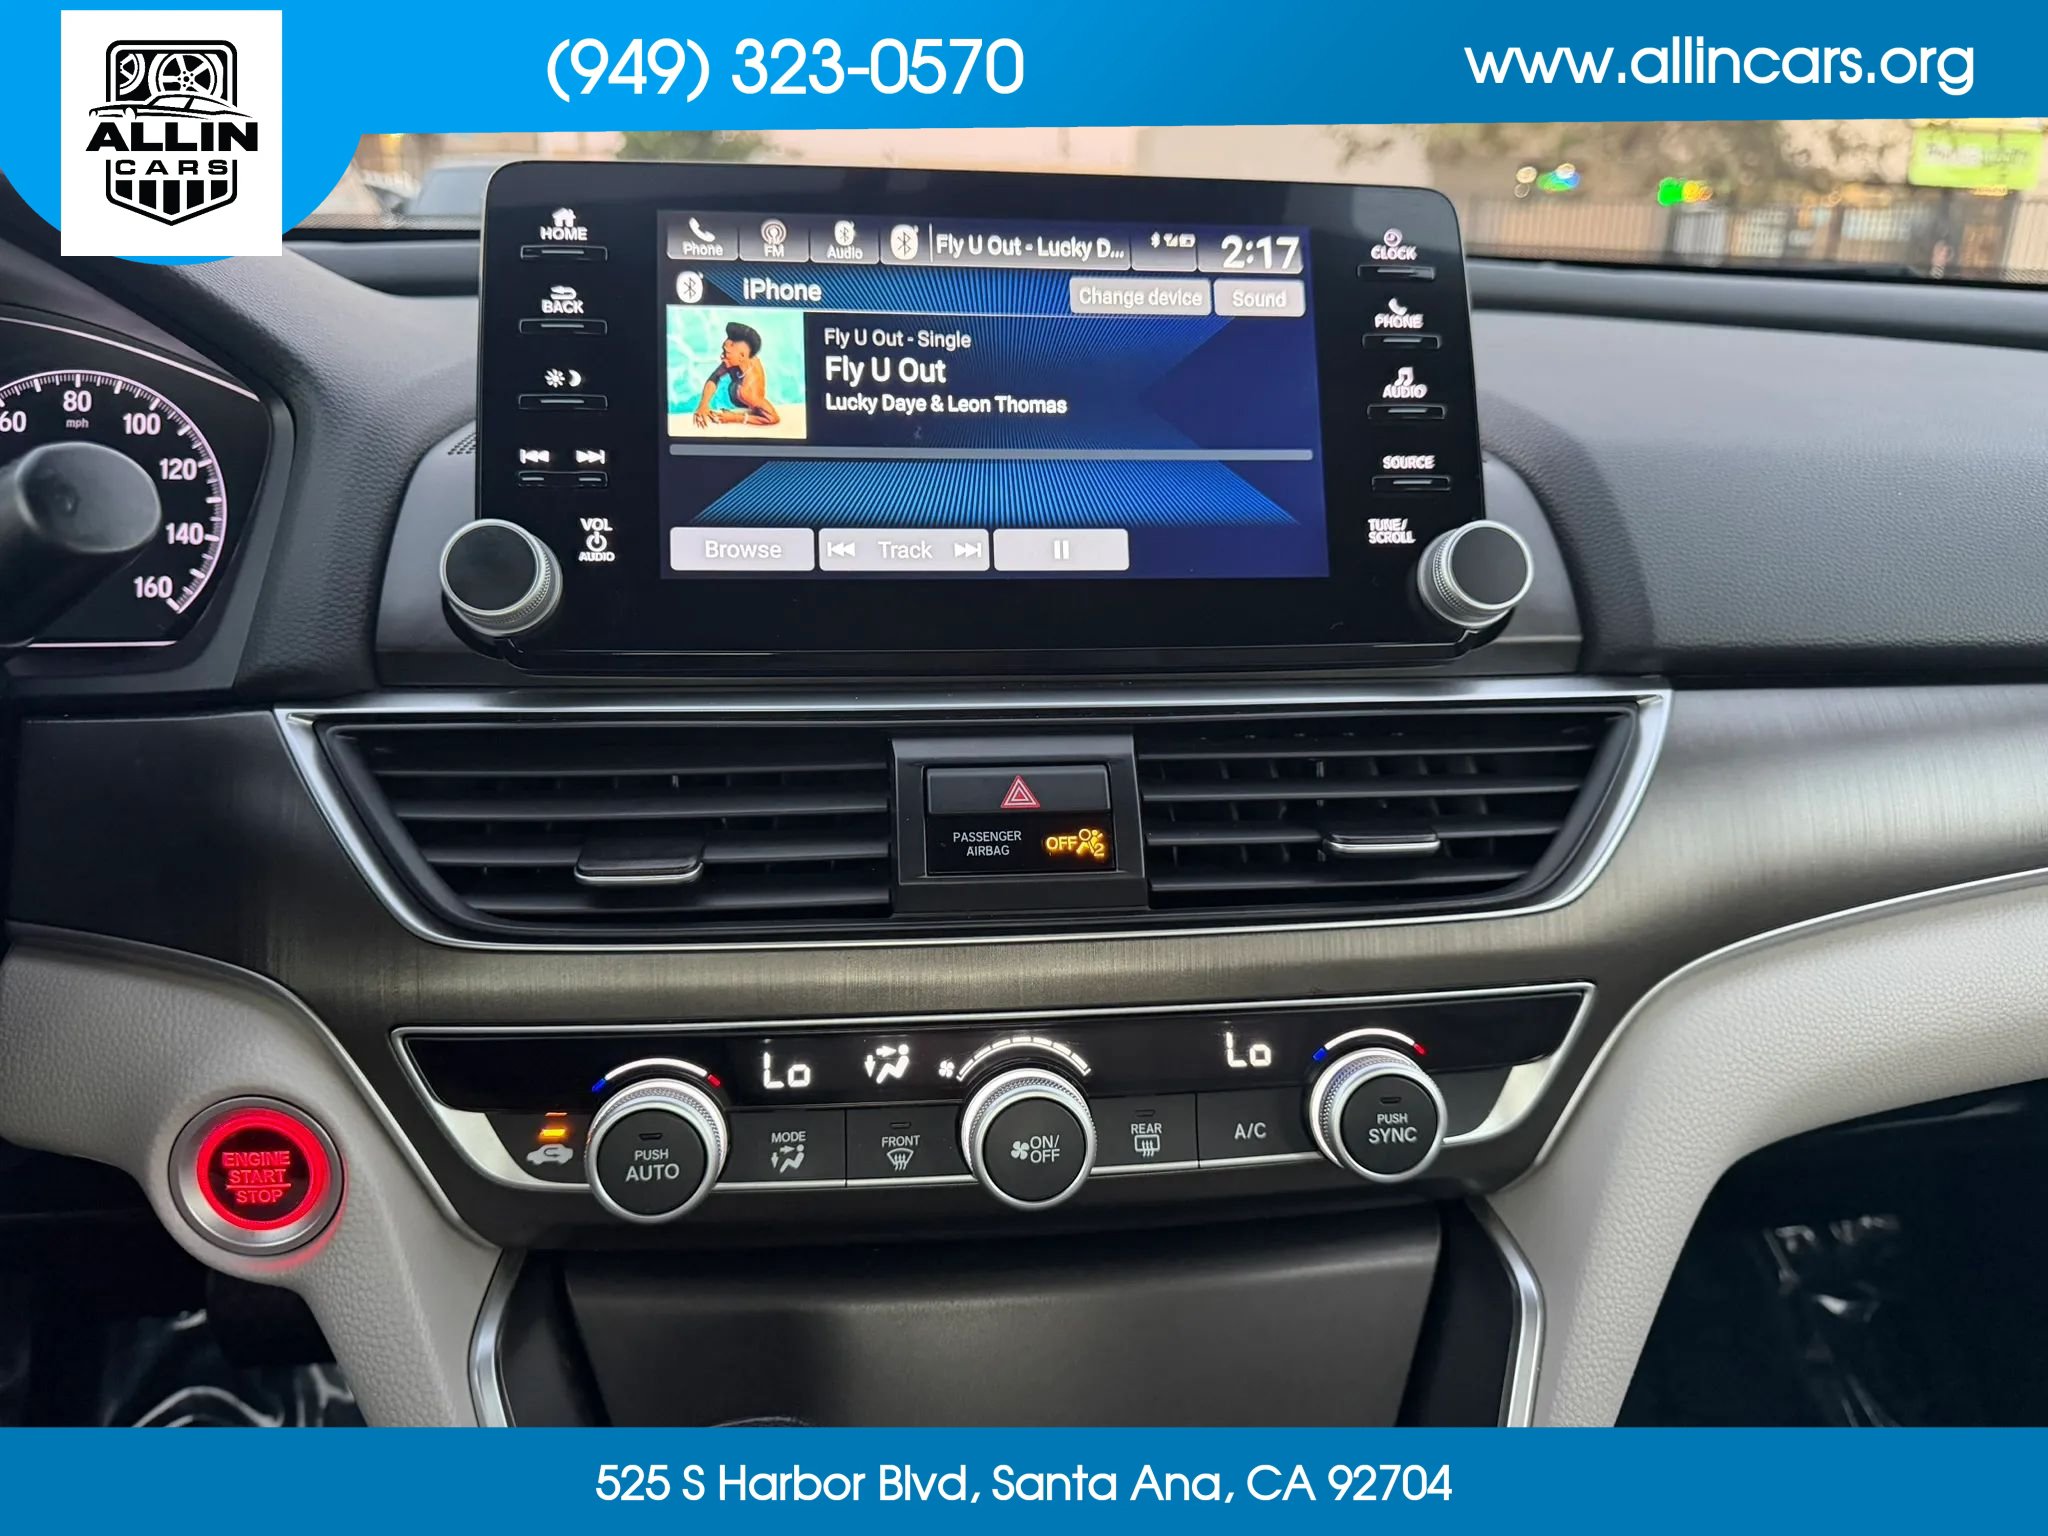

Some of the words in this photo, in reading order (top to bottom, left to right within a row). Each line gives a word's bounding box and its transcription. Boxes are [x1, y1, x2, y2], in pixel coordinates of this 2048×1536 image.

[540, 226, 588, 241] HOME
[683, 241, 723, 256] Phone
[764, 244, 785, 258] FM
[827, 245, 863, 260] Audio
[936, 234, 964, 259] Fly
[969, 235, 983, 255] U
[988, 235, 1022, 257] Out
[1037, 236, 1091, 262] Lucky
[1221, 235, 1300, 269] 2:17
[1371, 245, 1417, 260] CLOCK
[743, 278, 822, 301] iPhone
[1079, 287, 1142, 309] Change
[1148, 288, 1202, 306] device
[1232, 290, 1287, 308] Sound
[541, 299, 584, 314] BACK
[1375, 314, 1424, 329] PHONE
[824, 328, 850, 350] Fly
[854, 329, 868, 346] U
[872, 329, 903, 347] Out
[917, 331, 972, 351] Single
[825, 356, 864, 387] Fly
[871, 357, 890, 382] U
[899, 358, 946, 384] Out
[1383, 384, 1428, 399] AUDIO
[63, 390, 92, 412] 80
[825, 393, 877, 416] Lucky
[882, 394, 927, 416] Daye
[931, 395, 944, 413] &
[948, 395, 990, 413] Leon
[994, 395, 1068, 414] Thomas
[0, 410, 27, 433] 60
[66, 418, 89, 429] mph
[123, 413, 161, 435] 100
[159, 458, 198, 480] 120
[1382, 455, 1435, 469] SOURCE
[580, 517, 613, 531] VOL
[1367, 518, 1408, 532] TUNE/
[165, 522, 204, 545] 140
[1368, 531, 1416, 544] SCROLL
[578, 551, 616, 562] AUDIO
[704, 540, 782, 559] Browse
[878, 541, 933, 560] Track
[133, 576, 174, 599] 160
[953, 830, 1022, 843] PASSENGER
[1046, 836, 1077, 850] OFF
[966, 845, 1010, 857] AIRBAG
[1226, 1031, 1272, 1068] Lo
[763, 1052, 811, 1089] Lo
[1377, 1113, 1409, 1125] PUSH
[1131, 1123, 1162, 1135] REAR
[1234, 1122, 1267, 1140] A/C
[1368, 1126, 1418, 1144] SYNC
[771, 1131, 807, 1143] MODE
[881, 1135, 920, 1148] FRONT
[1030, 1134, 1060, 1149] ON/
[222, 1151, 291, 1167] ENGINE
[634, 1149, 669, 1161] PUSH
[1030, 1150, 1060, 1163] OFF
[229, 1169, 287, 1184] START
[625, 1164, 680, 1182] AUTO
[236, 1189, 283, 1204] STOP
